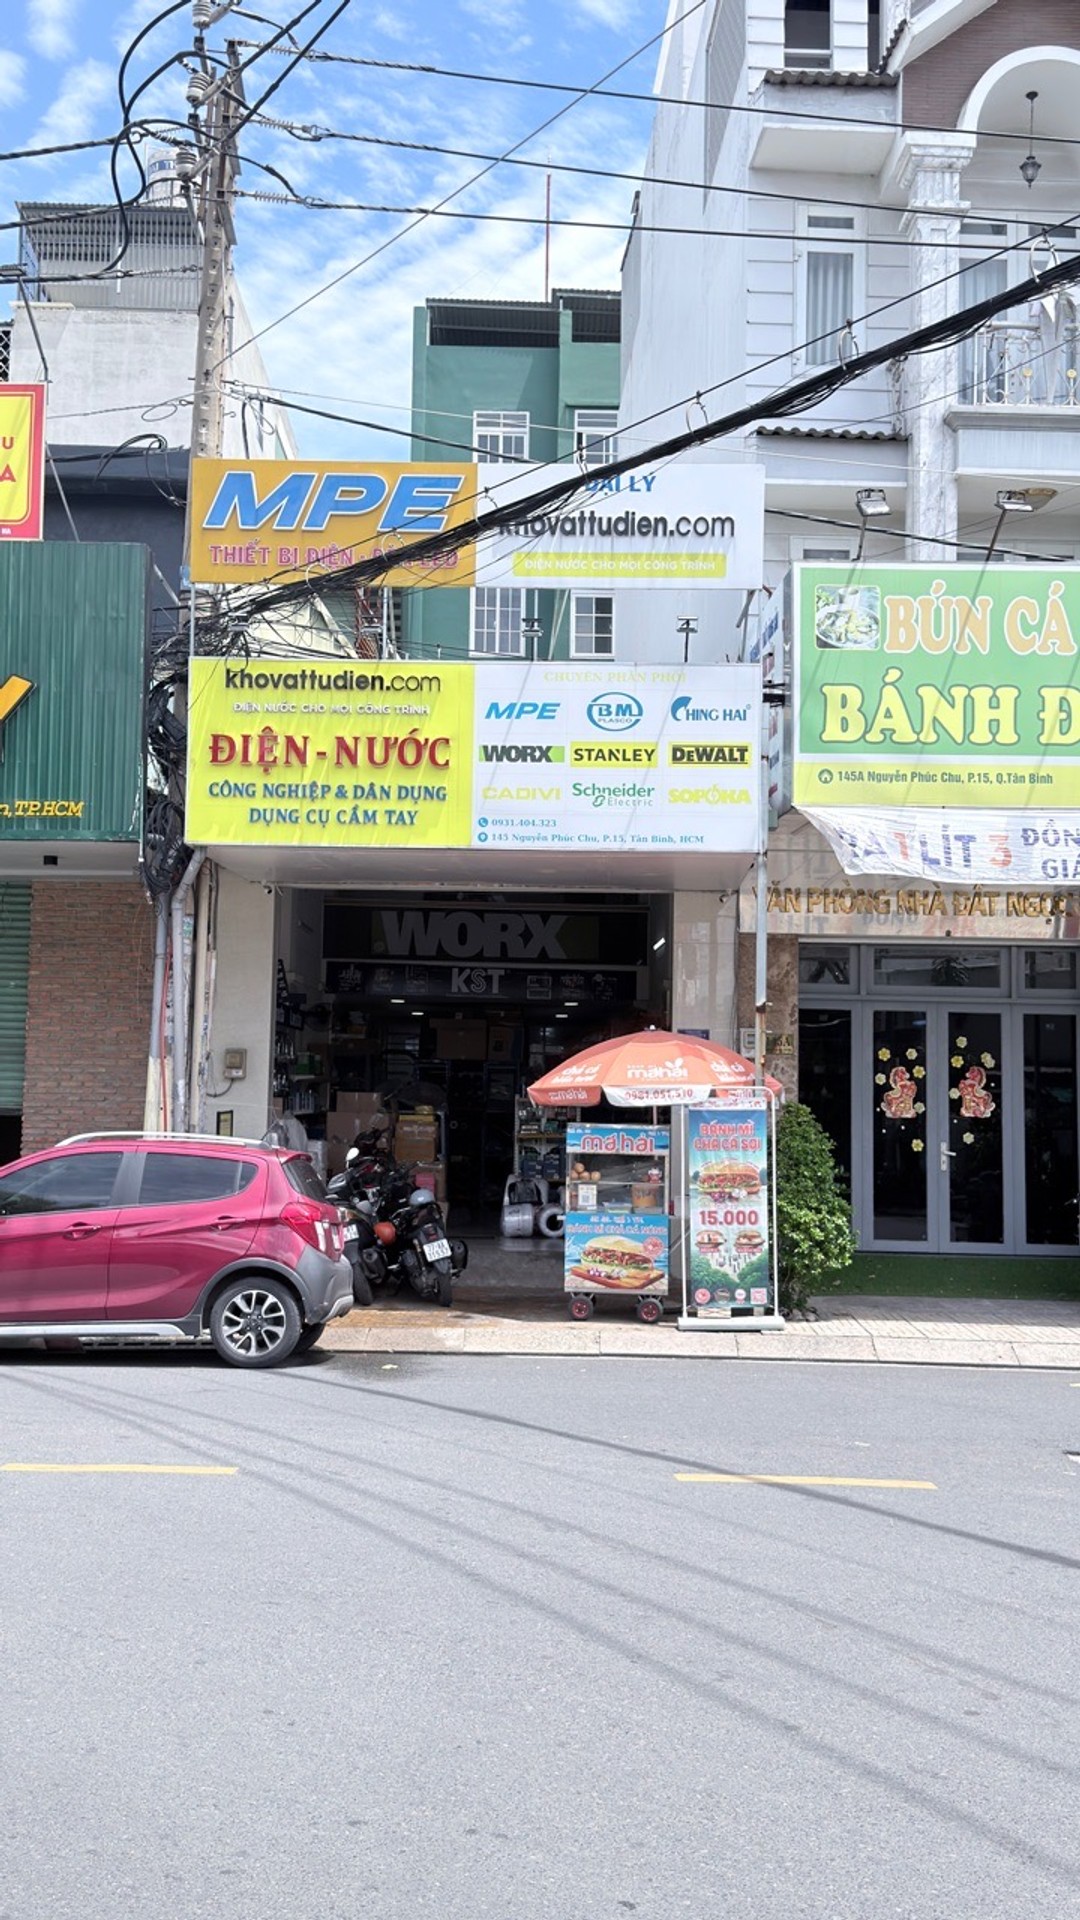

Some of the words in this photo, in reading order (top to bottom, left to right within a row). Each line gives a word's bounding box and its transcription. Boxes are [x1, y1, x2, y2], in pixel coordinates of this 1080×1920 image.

[202, 471, 466, 532] MPE
[209, 537, 271, 566] THIẾT
[277, 546, 299, 570] BỊ
[305, 543, 355, 571] ĐIỆN
[524, 559, 552, 571] ĐIỆN
[554, 558, 588, 570] NƯỚC
[591, 561, 616, 570] CHO
[619, 561, 641, 572] MỌI
[643, 559, 678, 570] CÔNG
[681, 559, 716, 571] TRÌNH
[884, 579, 993, 655] BÚN
[1004, 580, 1078, 656] CÁ
[225, 668, 441, 692] khovattudien.com
[233, 702, 261, 715] ĐIỆN
[264, 701, 296, 714] NƯỚC
[300, 704, 326, 714] CHO
[356, 702, 391, 715] CÔNG
[394, 703, 430, 715] TRÌNH
[484, 702, 561, 720] MPE
[598, 704, 632, 717] BM
[722, 708, 747, 721] HAI
[819, 666, 1020, 746] BÁNH
[208, 725, 310, 774] ĐIỆN
[334, 728, 450, 769] NƯỚC
[482, 745, 553, 763] WORX
[573, 748, 656, 762] STANLEY
[838, 770, 865, 782] 145A
[867, 769, 908, 784] Nguyễn
[910, 770, 938, 783] Phúc
[940, 771, 965, 784] Chu,
[967, 772, 993, 785] P.15,
[995, 772, 1026, 785] Q.Tân
[1028, 772, 1053, 784] Bình
[208, 780, 257, 798] CÔNG
[262, 780, 332, 803] NGHIỆP
[335, 786, 349, 800] &
[352, 782, 392, 801] DÂN
[397, 785, 448, 805] DỤNG
[482, 786, 561, 800] CADIVI
[572, 782, 655, 797] Schneider
[607, 797, 653, 806] Electric
[249, 808, 300, 827] DỤNG
[305, 809, 330, 828] CỤ
[336, 805, 378, 826] CẦM
[385, 810, 419, 826] TAY
[492, 833, 509, 841] 145
[680, 835, 705, 843] HCM
[807, 879, 891, 915] PHÒNG
[896, 881, 948, 917] NHÀ
[381, 910, 568, 960] WORX
[451, 967, 506, 995] KST
[700, 1119, 736, 1136] BÁNH
[737, 1119, 755, 1136] MÌ
[699, 1210, 759, 1225] 15.000
